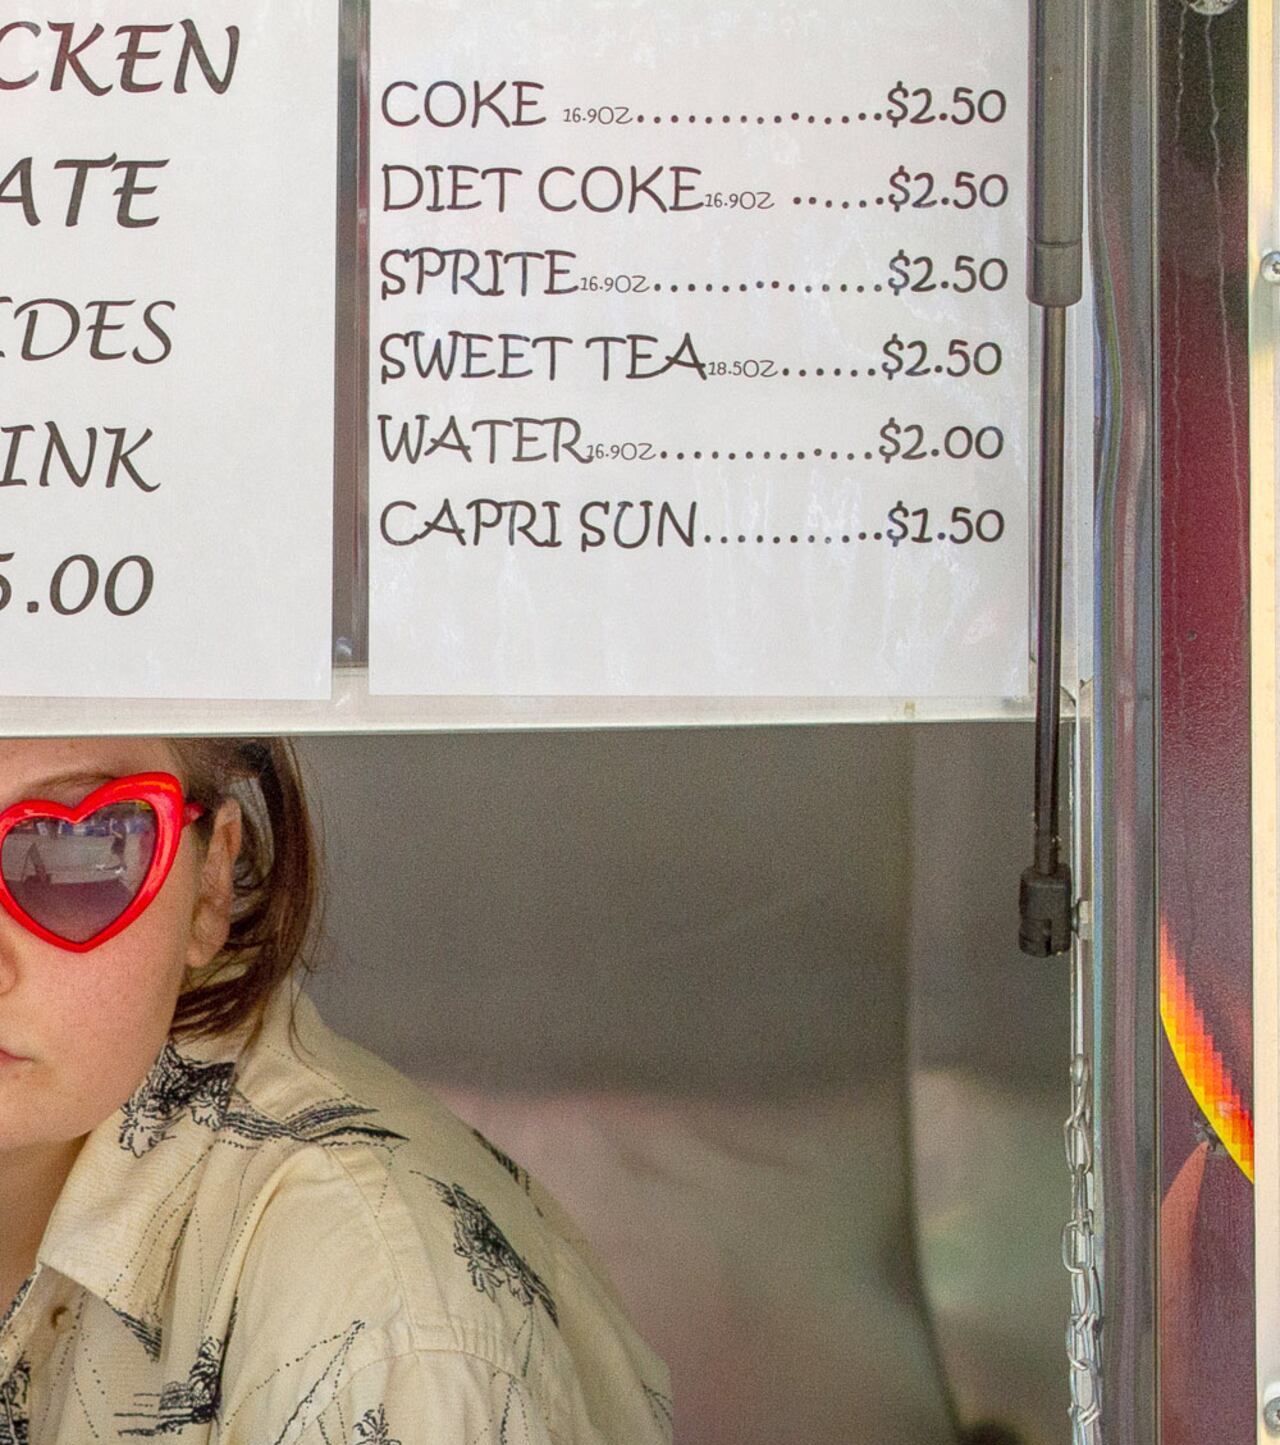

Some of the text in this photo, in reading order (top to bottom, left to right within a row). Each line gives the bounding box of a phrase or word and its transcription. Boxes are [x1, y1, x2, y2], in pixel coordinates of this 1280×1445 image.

[380, 79, 548, 130] COKE
[380, 162, 524, 214] DIET
[537, 164, 706, 215] COKE
[378, 245, 581, 302] SPRITE
[378, 329, 575, 386] SWEET
[584, 331, 709, 383] TEA
[376, 413, 594, 466] WATER
[378, 497, 564, 549] CAPRI
[578, 499, 698, 554] SUN
